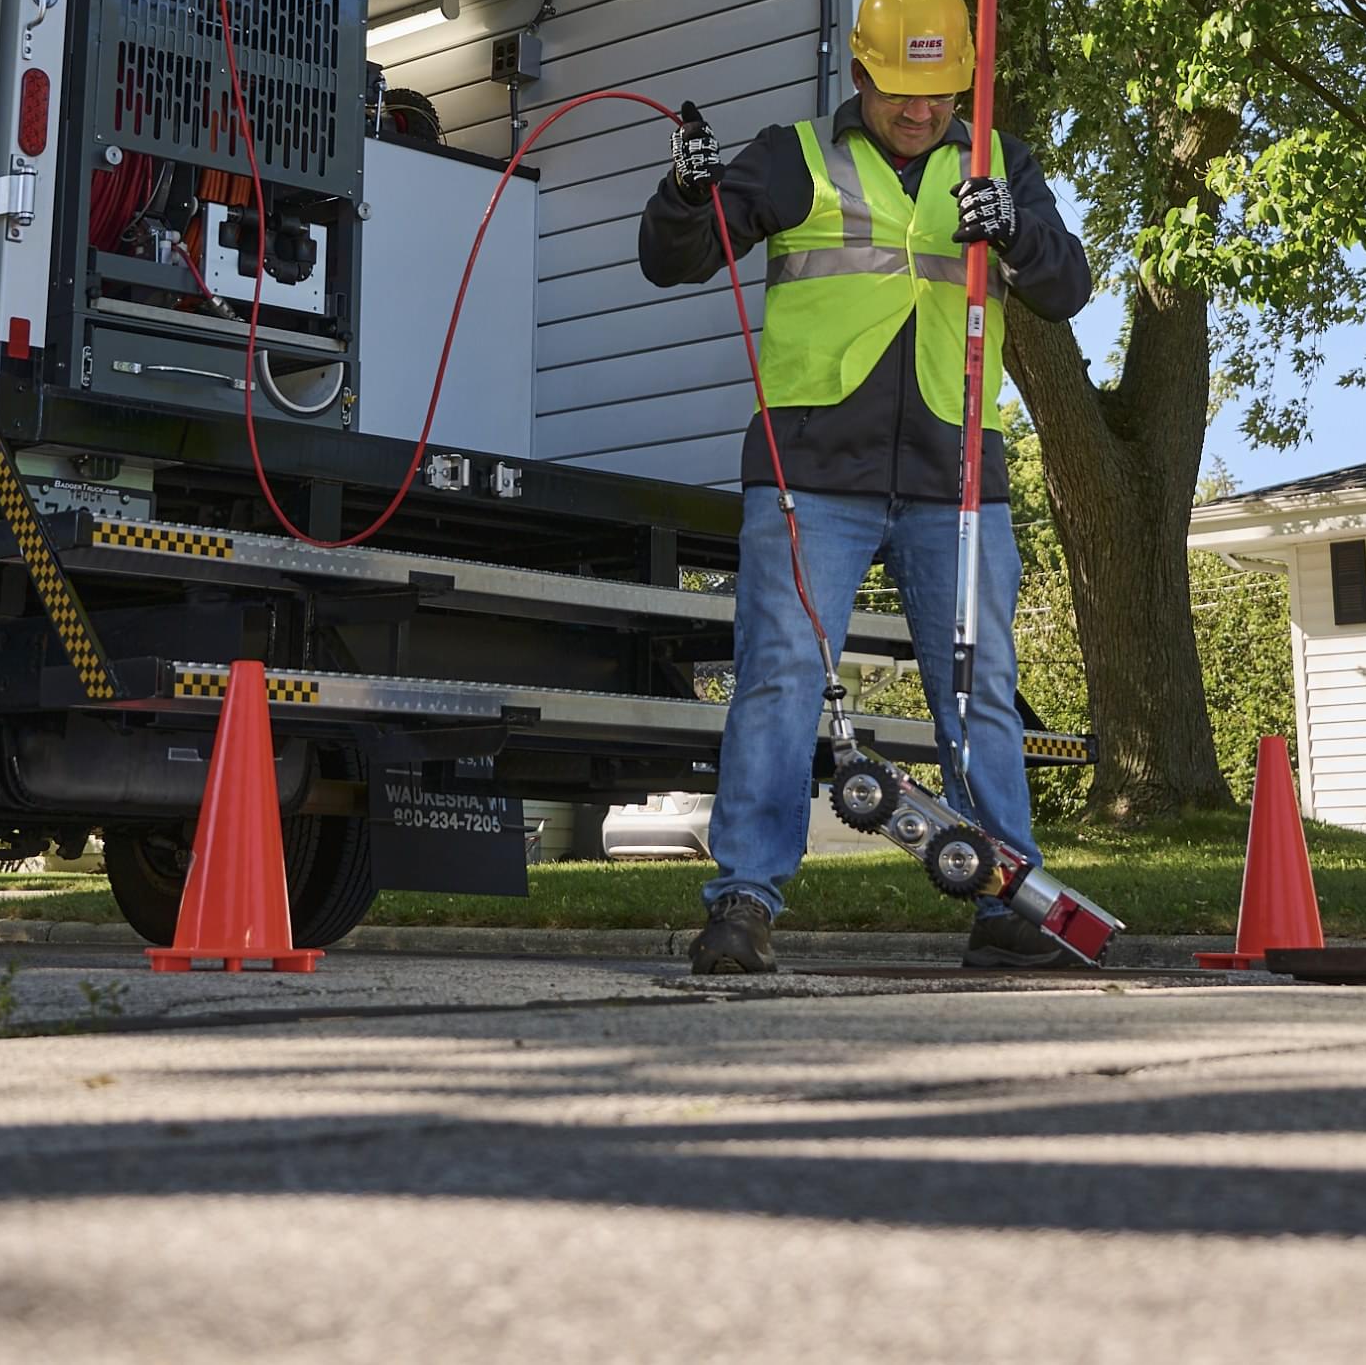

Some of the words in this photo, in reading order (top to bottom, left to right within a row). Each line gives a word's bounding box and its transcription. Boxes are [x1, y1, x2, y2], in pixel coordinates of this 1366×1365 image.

[910, 39, 943, 48] ARIES
[69, 491, 103, 502] TRUCK
[393, 808, 502, 833] 800-234-7205
